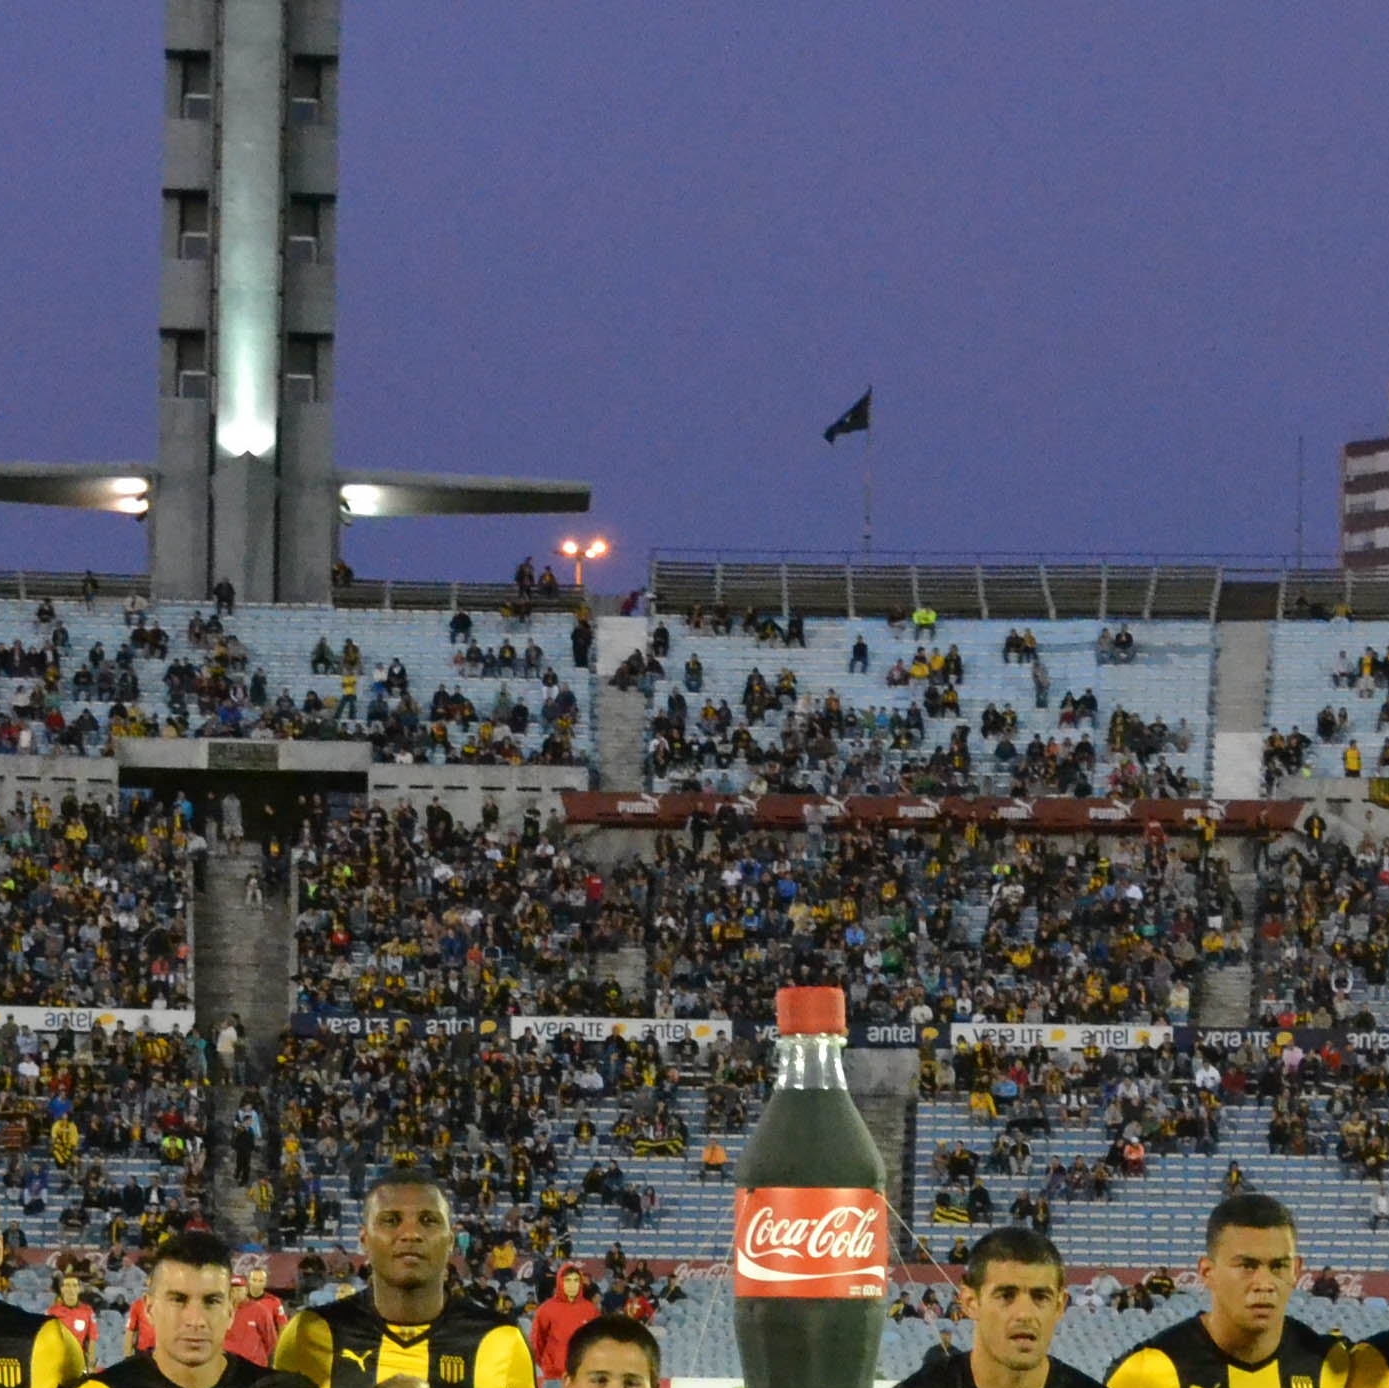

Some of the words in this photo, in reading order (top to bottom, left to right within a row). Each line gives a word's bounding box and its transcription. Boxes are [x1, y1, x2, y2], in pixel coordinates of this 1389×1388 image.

[899, 805, 936, 818] PUMA
[1089, 807, 1126, 820] PUMA
[866, 1026, 916, 1044] antel
[1020, 1028, 1044, 1045] LTE
[1081, 1028, 1129, 1046] antel
[746, 1206, 879, 1259] Coca-Cola
